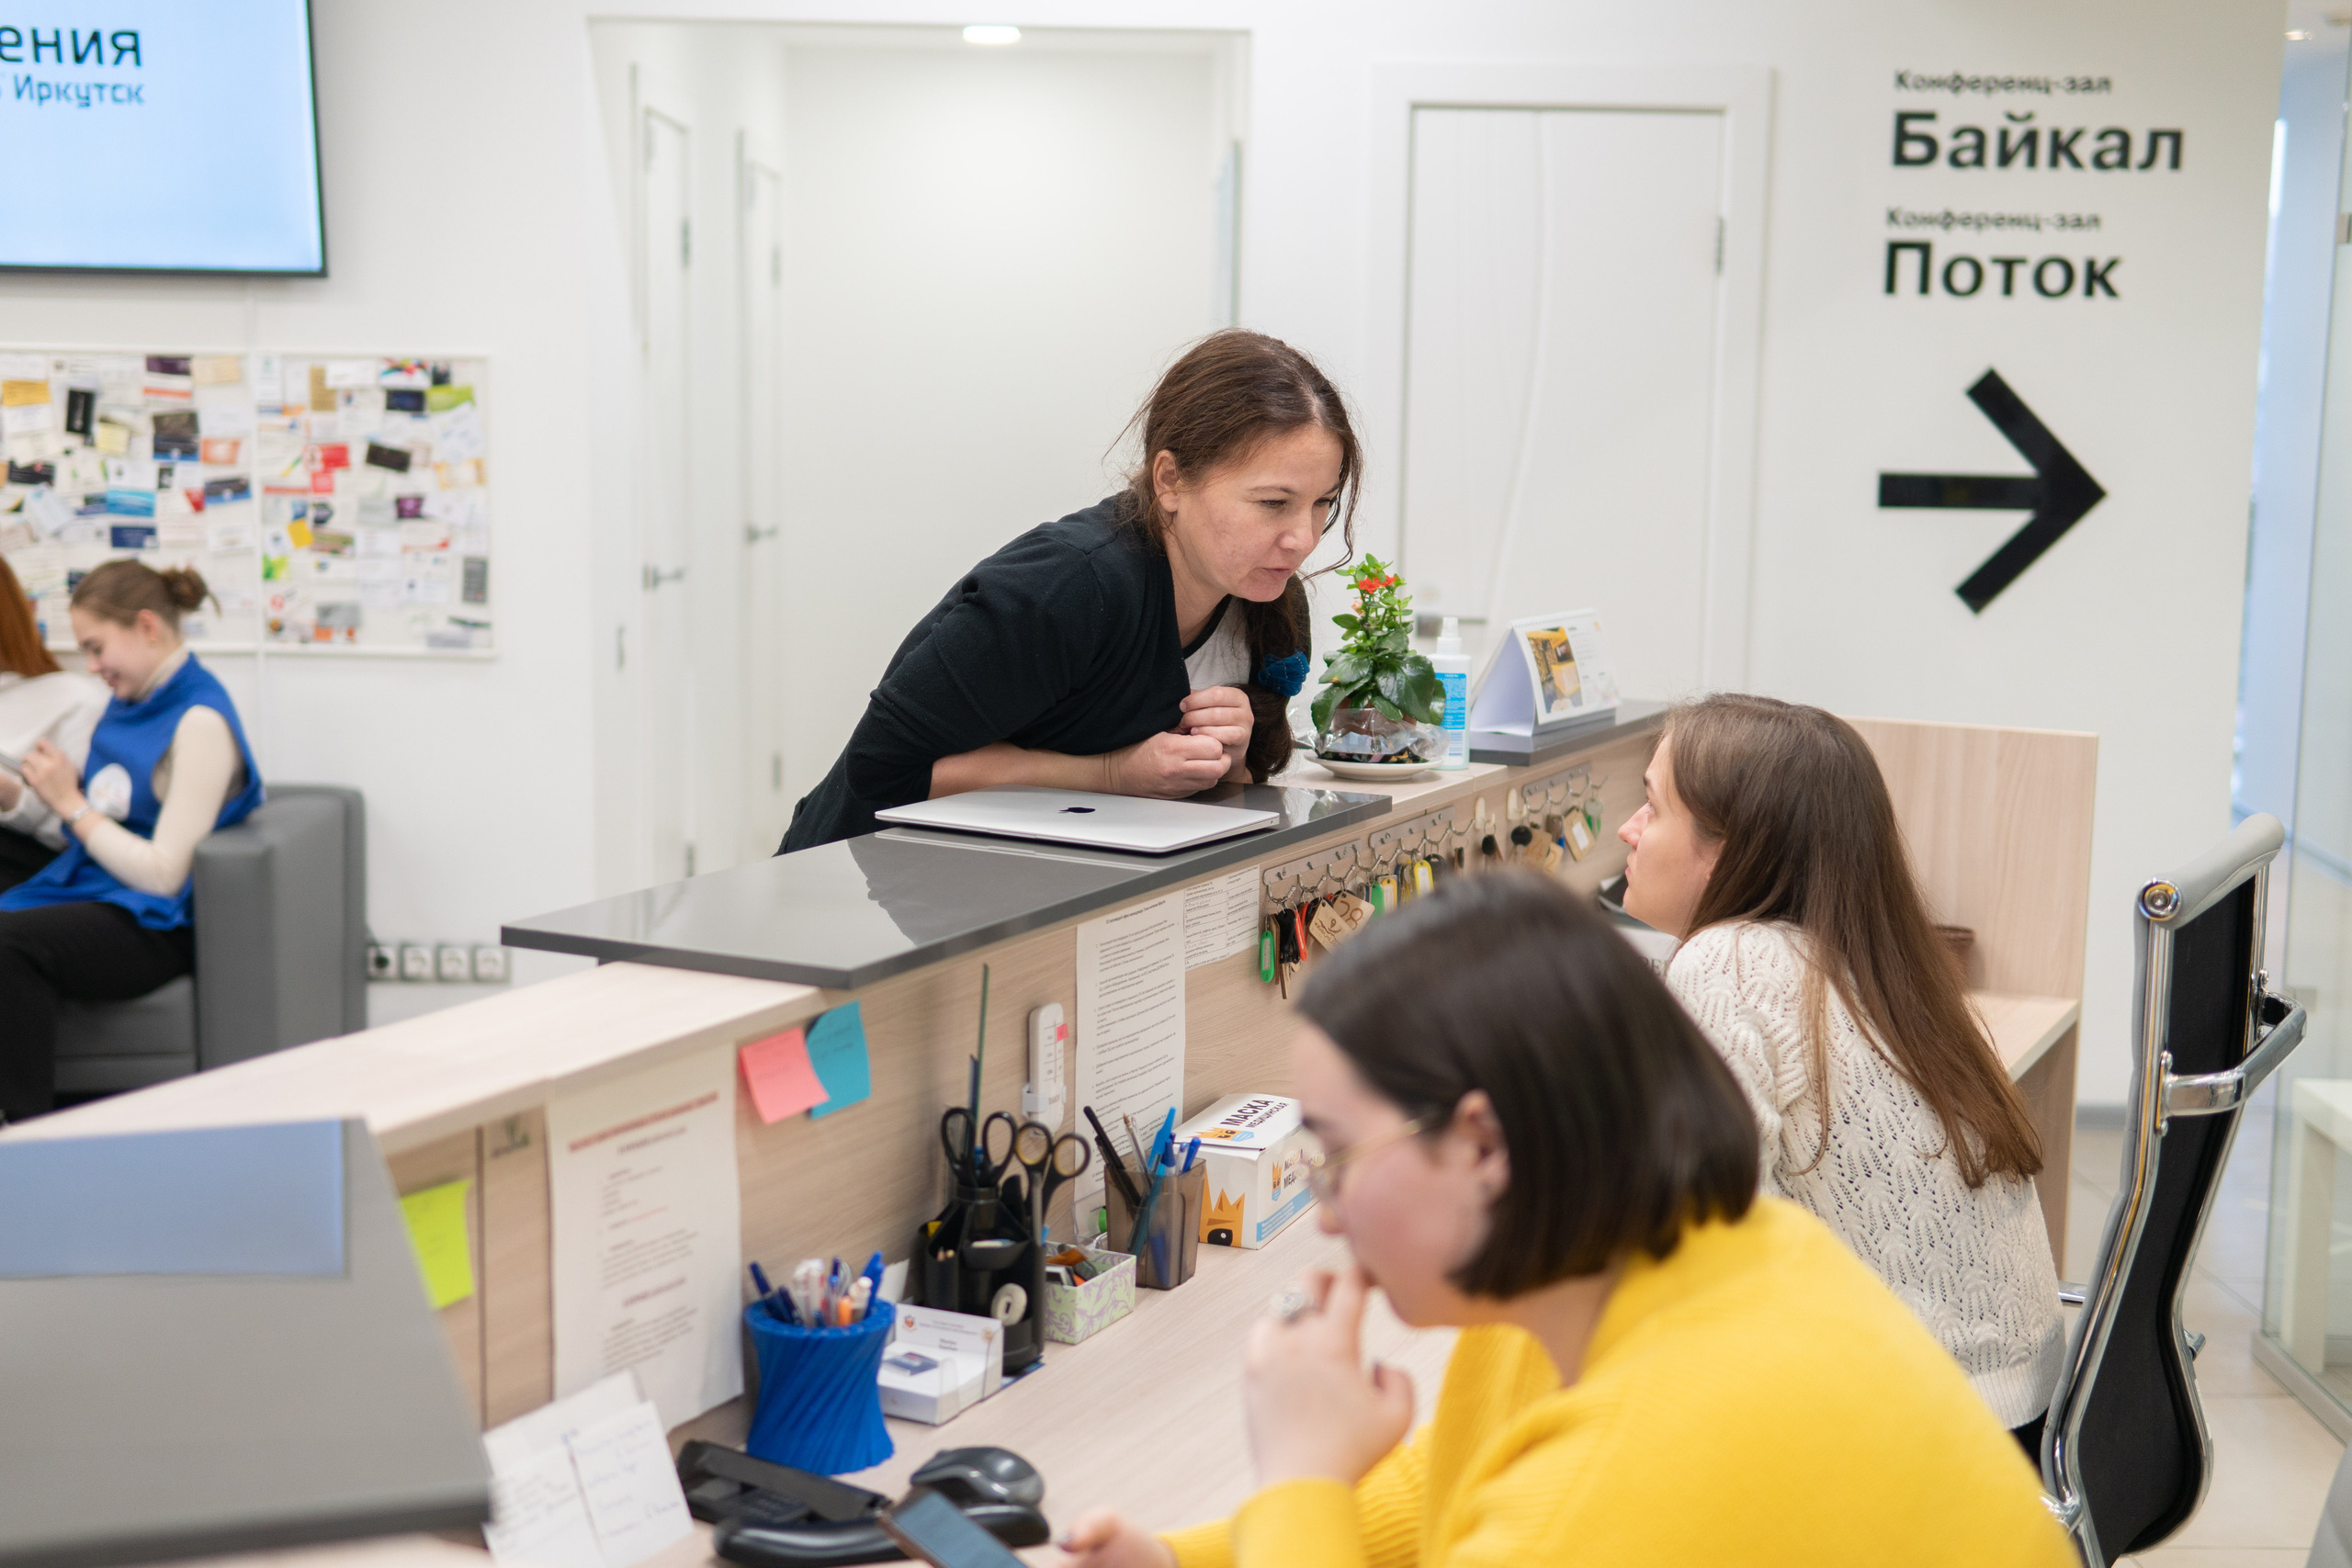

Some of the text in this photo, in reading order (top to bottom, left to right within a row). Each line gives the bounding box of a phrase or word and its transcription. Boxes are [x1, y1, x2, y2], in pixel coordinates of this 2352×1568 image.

[14, 73, 143, 108] Иркутск
[1894, 71, 2112, 95] Конференц-зал
[1893, 110, 2184, 171] Байкал
[1886, 208, 2101, 231] Конференц-зал
[1884, 240, 2120, 299] Поток
[1219, 1100, 1274, 1126] МАСКА
